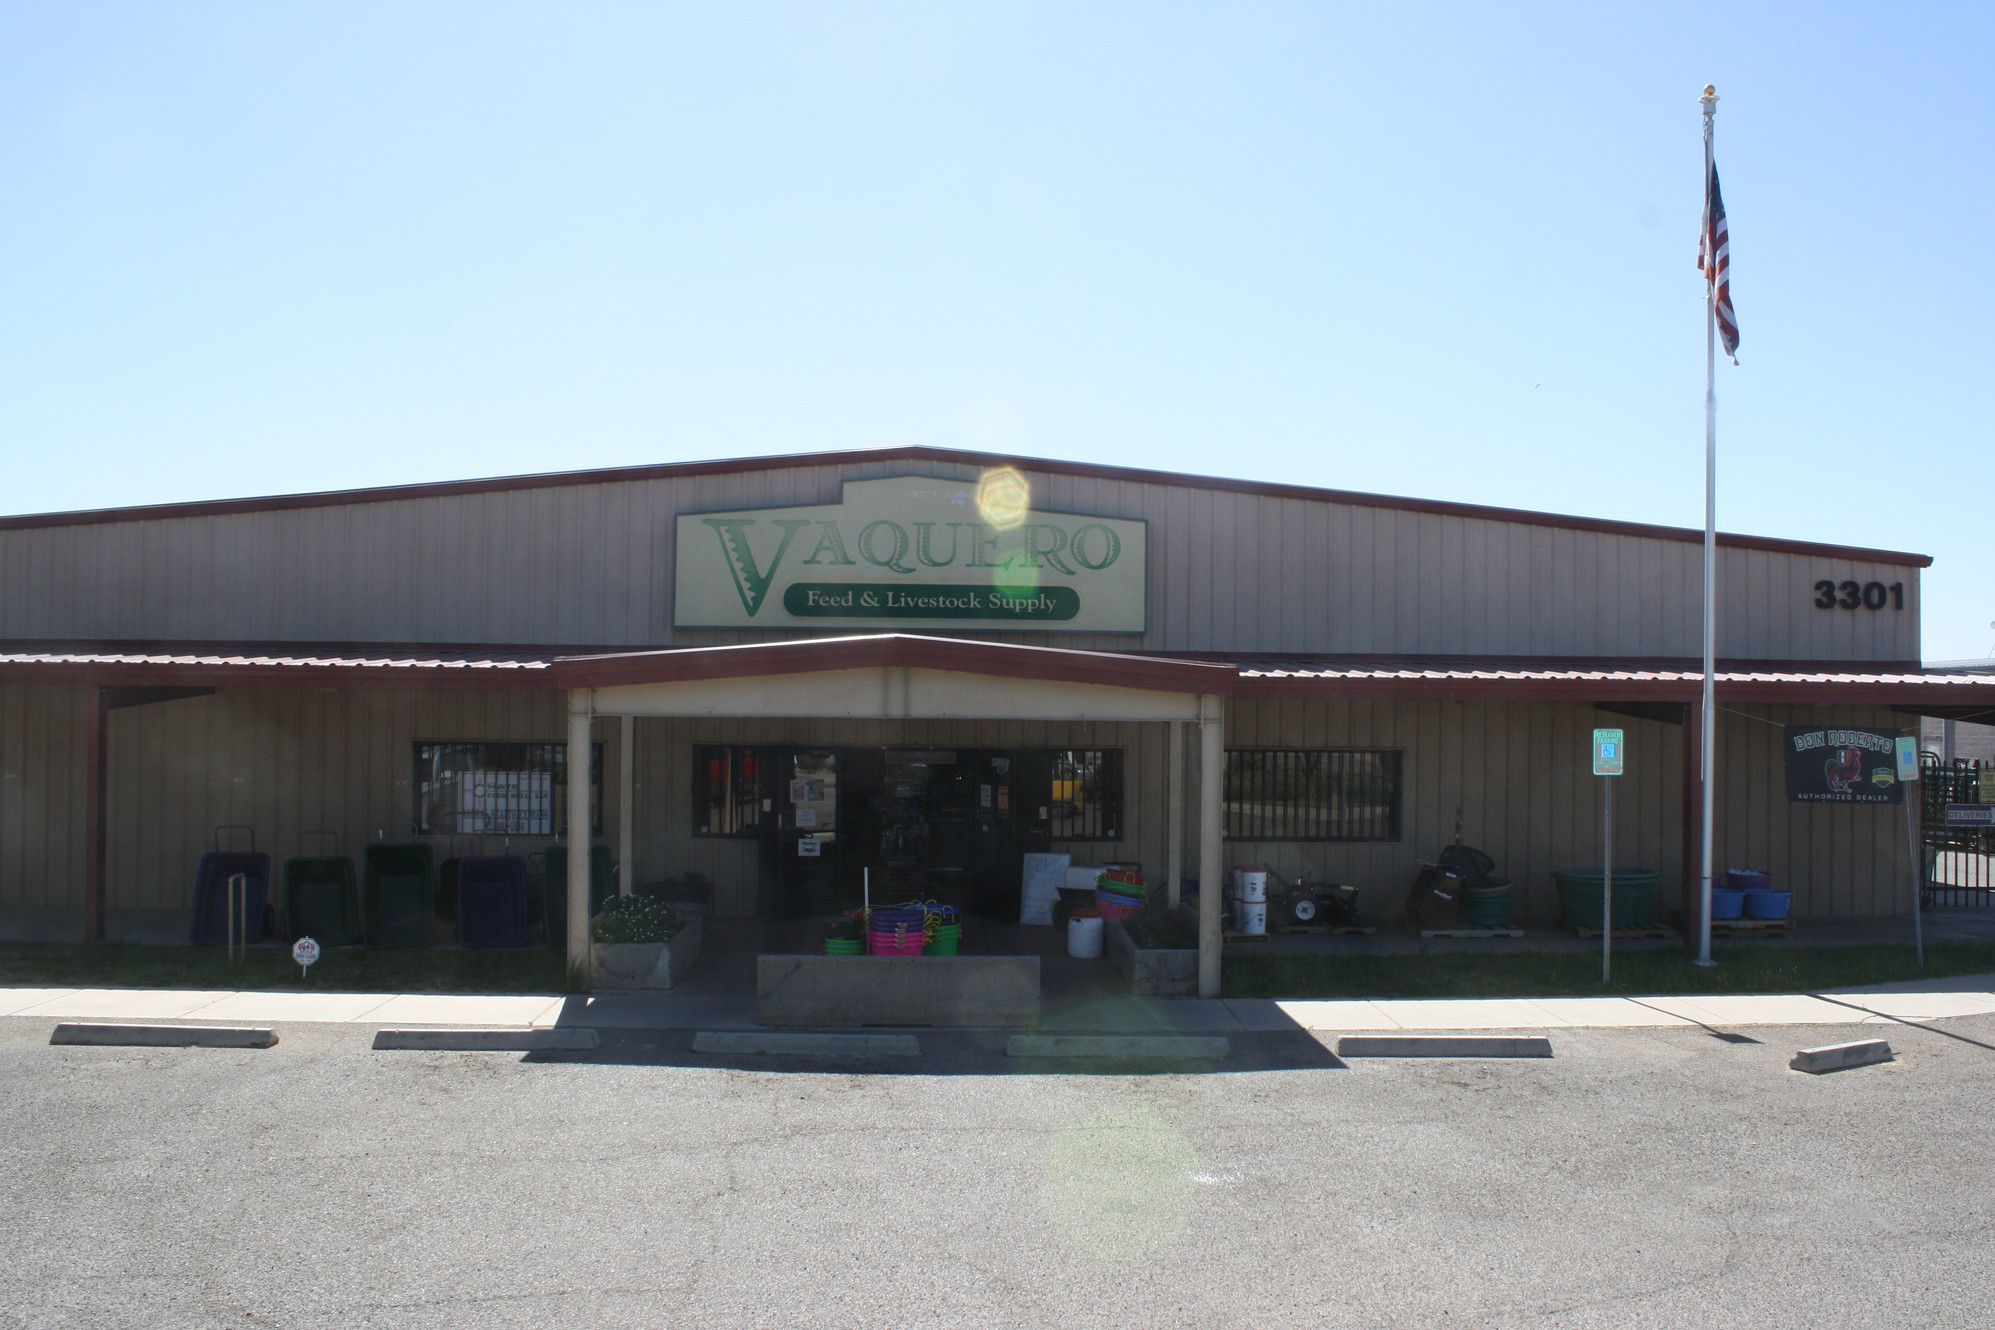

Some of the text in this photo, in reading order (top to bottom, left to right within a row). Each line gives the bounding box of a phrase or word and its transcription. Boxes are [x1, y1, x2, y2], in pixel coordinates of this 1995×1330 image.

[702, 517, 1122, 618] VAQUERO
[806, 590, 1057, 613] Feed & Livestock Supply
[1814, 580, 1904, 611] 3301
[1793, 730, 1893, 754] DON ROBERTO
[1856, 793, 1888, 801] DEALER
[1949, 811, 1993, 819] DELIVERIES
